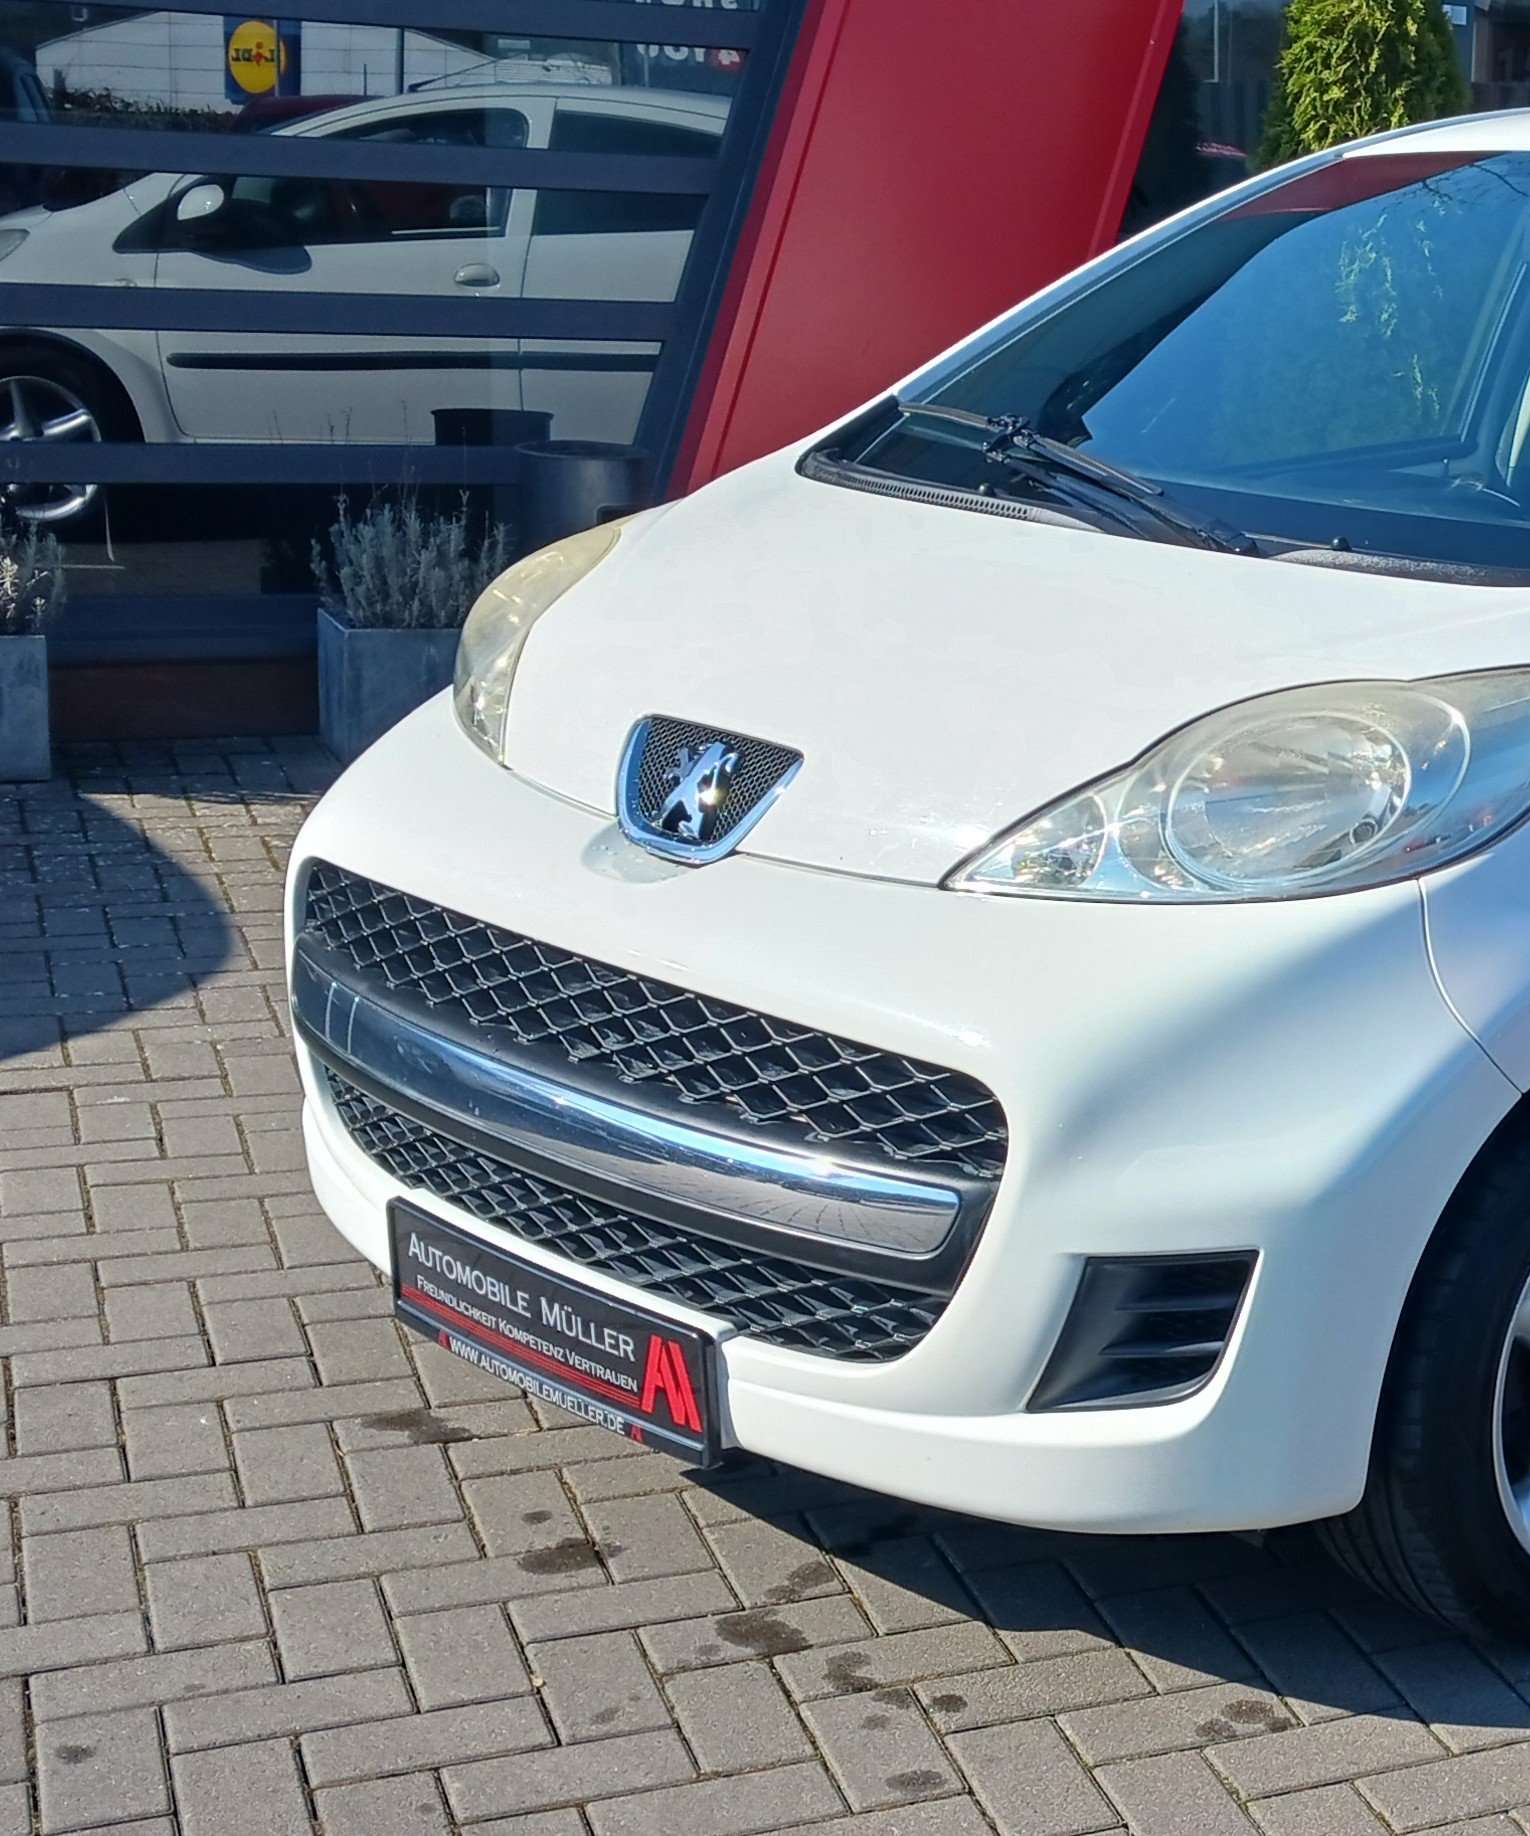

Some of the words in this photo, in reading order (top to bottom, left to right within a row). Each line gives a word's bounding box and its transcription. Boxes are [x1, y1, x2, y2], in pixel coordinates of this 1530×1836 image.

[407, 1231, 532, 1319] AUTOMOBILE
[539, 1296, 636, 1362] MÜLLER
[416, 1274, 497, 1330] FREUNDLICHKEIT
[498, 1317, 565, 1363] KOMPETENZ
[565, 1347, 639, 1393] VERTRAUEN
